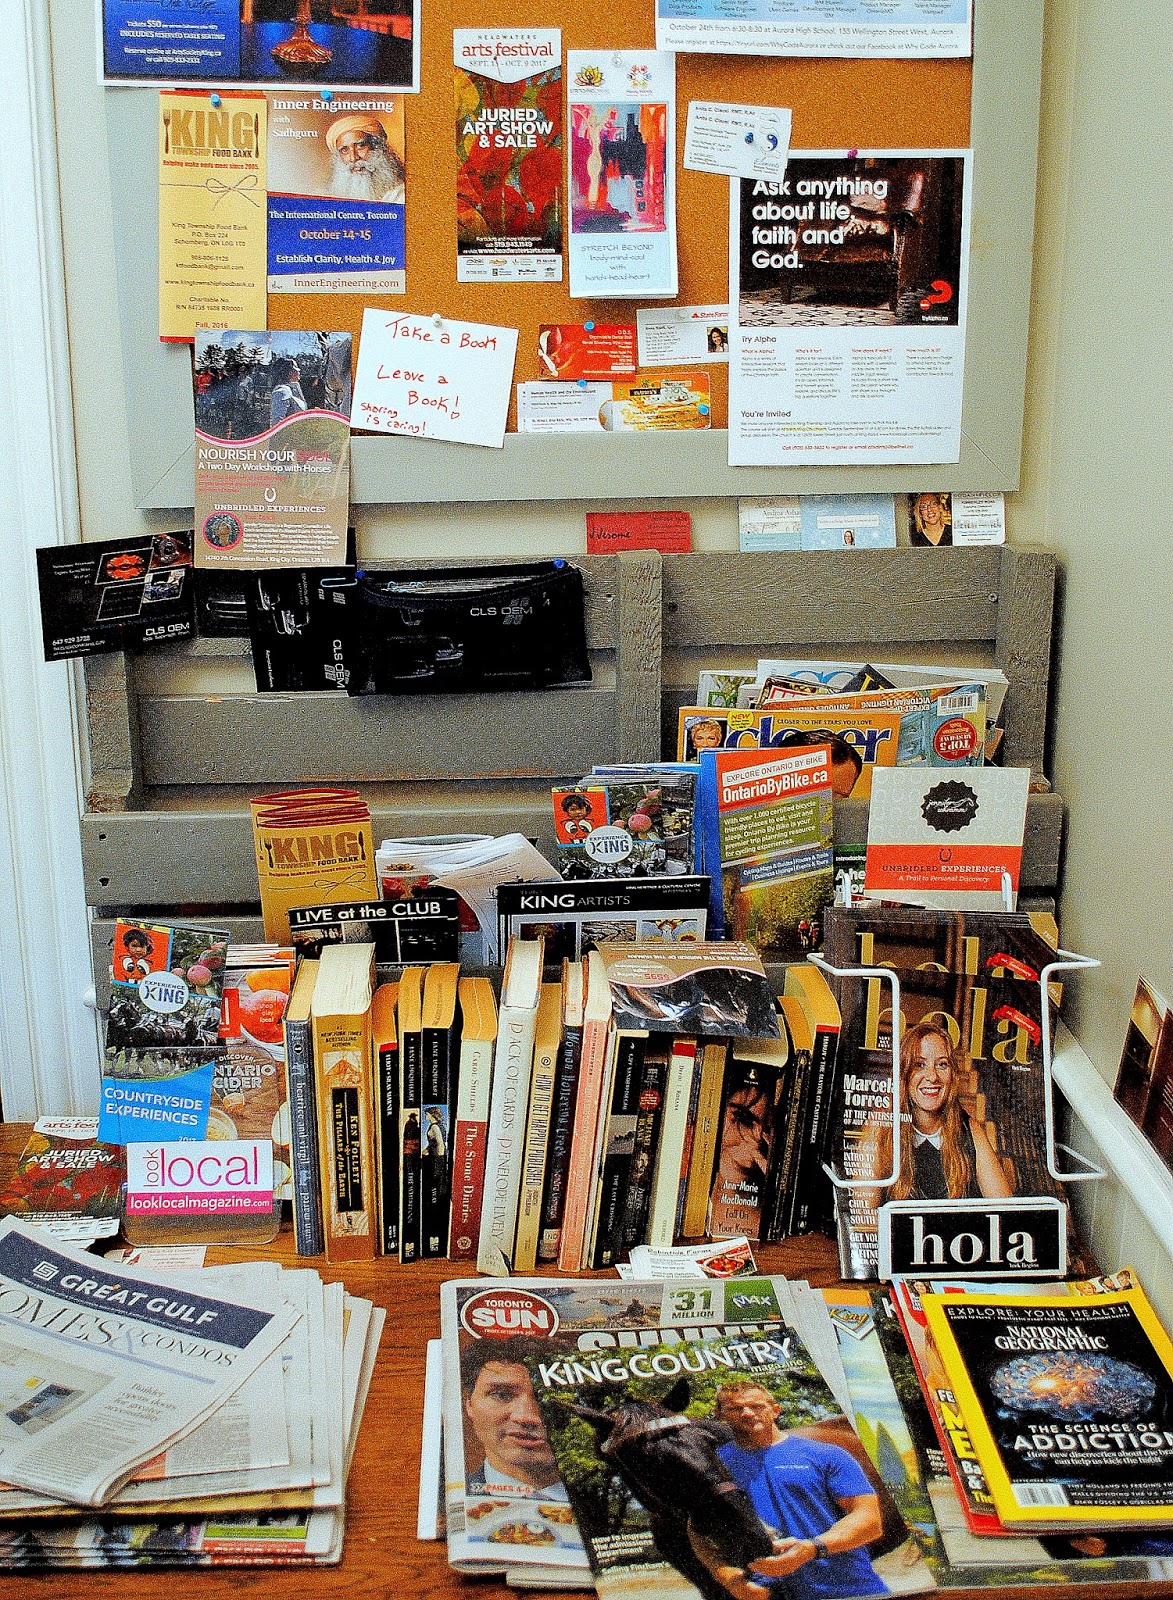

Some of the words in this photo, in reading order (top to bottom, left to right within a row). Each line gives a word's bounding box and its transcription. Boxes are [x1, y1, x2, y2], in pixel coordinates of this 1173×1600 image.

[852, 28, 888, 37] Wellington
[462, 43, 493, 57] arts
[495, 42, 554, 57] festival
[273, 99, 310, 111] Inner
[312, 99, 394, 113] Engineering
[273, 116, 291, 124] with
[478, 108, 538, 122] JURIED
[172, 109, 254, 149] KING
[462, 122, 498, 135] ART
[501, 122, 554, 135] SHOW
[479, 135, 491, 148] &
[494, 135, 538, 148] SALE
[212, 149, 232, 158] FOOD
[233, 149, 253, 159] BANK
[752, 180, 791, 196] Ask
[796, 177, 888, 199] anything
[269, 211, 285, 219] The
[285, 211, 336, 219] International
[366, 212, 398, 220] Toronto
[752, 202, 815, 221] about
[299, 229, 341, 240] October
[343, 230, 372, 241] 14-15
[752, 226, 797, 245] faith
[802, 226, 845, 245] and
[276, 254, 313, 264] Establish
[345, 255, 373, 264] Health
[382, 255, 396, 266] Joy
[751, 250, 804, 269] God.
[294, 278, 400, 289] InnerEngineering.com
[212, 322, 229, 330] 2016
[385, 315, 435, 342] Take
[440, 333, 451, 345] a
[459, 332, 498, 351] Book
[754, 335, 777, 343] Alpha
[376, 364, 426, 383] Leave
[437, 375, 450, 385] a
[360, 402, 398, 419] Sharing
[741, 410, 765, 418] You're
[765, 410, 792, 418] Invited
[366, 414, 380, 426] is
[198, 448, 258, 461] NOURISH
[258, 449, 295, 462] YOUR
[197, 462, 206, 470] A
[206, 462, 223, 471] Two
[224, 463, 242, 473] Day
[241, 463, 286, 474] Workshop
[284, 464, 303, 473] with
[303, 464, 332, 474] Horses
[267, 505, 327, 514] EXPERIENCES
[470, 607, 498, 616] CLS
[501, 606, 533, 615] OEM
[145, 626, 166, 637] CLS
[167, 621, 190, 633] OEM
[332, 639, 345, 662] CLS
[731, 713, 751, 721] NEW
[776, 718, 801, 726] CLOSER
[726, 769, 761, 783] EXPLORE
[760, 762, 794, 777] ONTARIO
[794, 760, 805, 770] BY
[804, 754, 824, 767] BIKE
[722, 770, 829, 804] OntarioByBike.ca
[743, 828, 766, 838] Ontario
[271, 831, 359, 864] KING
[591, 841, 630, 855] KING
[317, 858, 337, 867] FOOD
[338, 856, 359, 864] BANK
[940, 865, 1007, 873] EXPERIENCES
[520, 893, 576, 910] KING
[576, 895, 631, 907] ARTISTS
[296, 908, 333, 925] LIVE
[337, 906, 356, 921] at
[359, 905, 388, 918] the
[392, 901, 442, 917] CLUB
[144, 979, 186, 990] EXPERIENCE
[144, 985, 185, 1005] KING
[859, 977, 1033, 1066] hola
[218, 1053, 255, 1062] DISCOVER
[213, 1064, 276, 1077] NTARIO
[506, 1065, 522, 1084] OF
[212, 1077, 262, 1089] CIDER
[536, 1073, 552, 1092] HOW
[843, 1074, 894, 1094] Marcel
[103, 1087, 203, 1112] COUNTRYSIDE
[295, 1081, 307, 1120] beatrice
[843, 1089, 890, 1109] Torres
[105, 1103, 199, 1126] EXPERIENCES
[335, 1102, 343, 1119] THE
[501, 1087, 519, 1129] CARDS
[533, 1103, 550, 1117] GET
[843, 1109, 854, 1119] AT
[854, 1110, 867, 1120] THE
[43, 1121, 72, 1129] arts
[350, 1115, 359, 1137] KEN
[335, 1120, 345, 1152] PILLARS
[464, 1125, 479, 1147] The
[530, 1119, 549, 1148] HAPPILY
[45, 1149, 102, 1157] JURIED
[65, 1154, 116, 1163] SHOW
[297, 1140, 309, 1165] virgil
[55, 1161, 97, 1169] SALE
[142, 1148, 160, 1188] look
[160, 1146, 259, 1188] local
[350, 1140, 361, 1185] FOLLETT
[462, 1149, 477, 1182] Stone
[494, 1136, 513, 1203] PENELOPE
[525, 1148, 544, 1187] PUBLISHED
[337, 1172, 347, 1198] EARTH
[723, 1179, 759, 1193] Ann-Marie
[130, 1194, 270, 1211] looklocalmagazine.com
[460, 1184, 475, 1224] Diaries
[720, 1193, 758, 1207] MacDonald
[490, 1205, 507, 1241] LIVELY
[850, 1215, 876, 1225] SOUTH
[910, 1214, 1038, 1266] hola
[59, 1273, 144, 1308] GREAT
[145, 1298, 219, 1327] GULF
[484, 1299, 534, 1310] TORONTO
[732, 1294, 771, 1310] MAX
[472, 1308, 549, 1330] SUN
[671, 1310, 715, 1320] MILLION
[829, 1306, 869, 1330] King
[1023, 1309, 1067, 1319] YOUR
[1070, 1305, 1130, 1318] HEALTH
[0, 1284, 118, 1345] OMES
[140, 1329, 240, 1369] CONDOS
[1007, 1325, 1088, 1339] NATIONAL
[994, 1335, 1109, 1351] GEOGRAPHIC
[1028, 1423, 1060, 1434] THE
[1065, 1423, 1131, 1434] SCIENCE
[1136, 1422, 1157, 1432] OF
[1013, 1431, 1173, 1451] ADDICTION
[486, 1484, 515, 1495] PAGES
